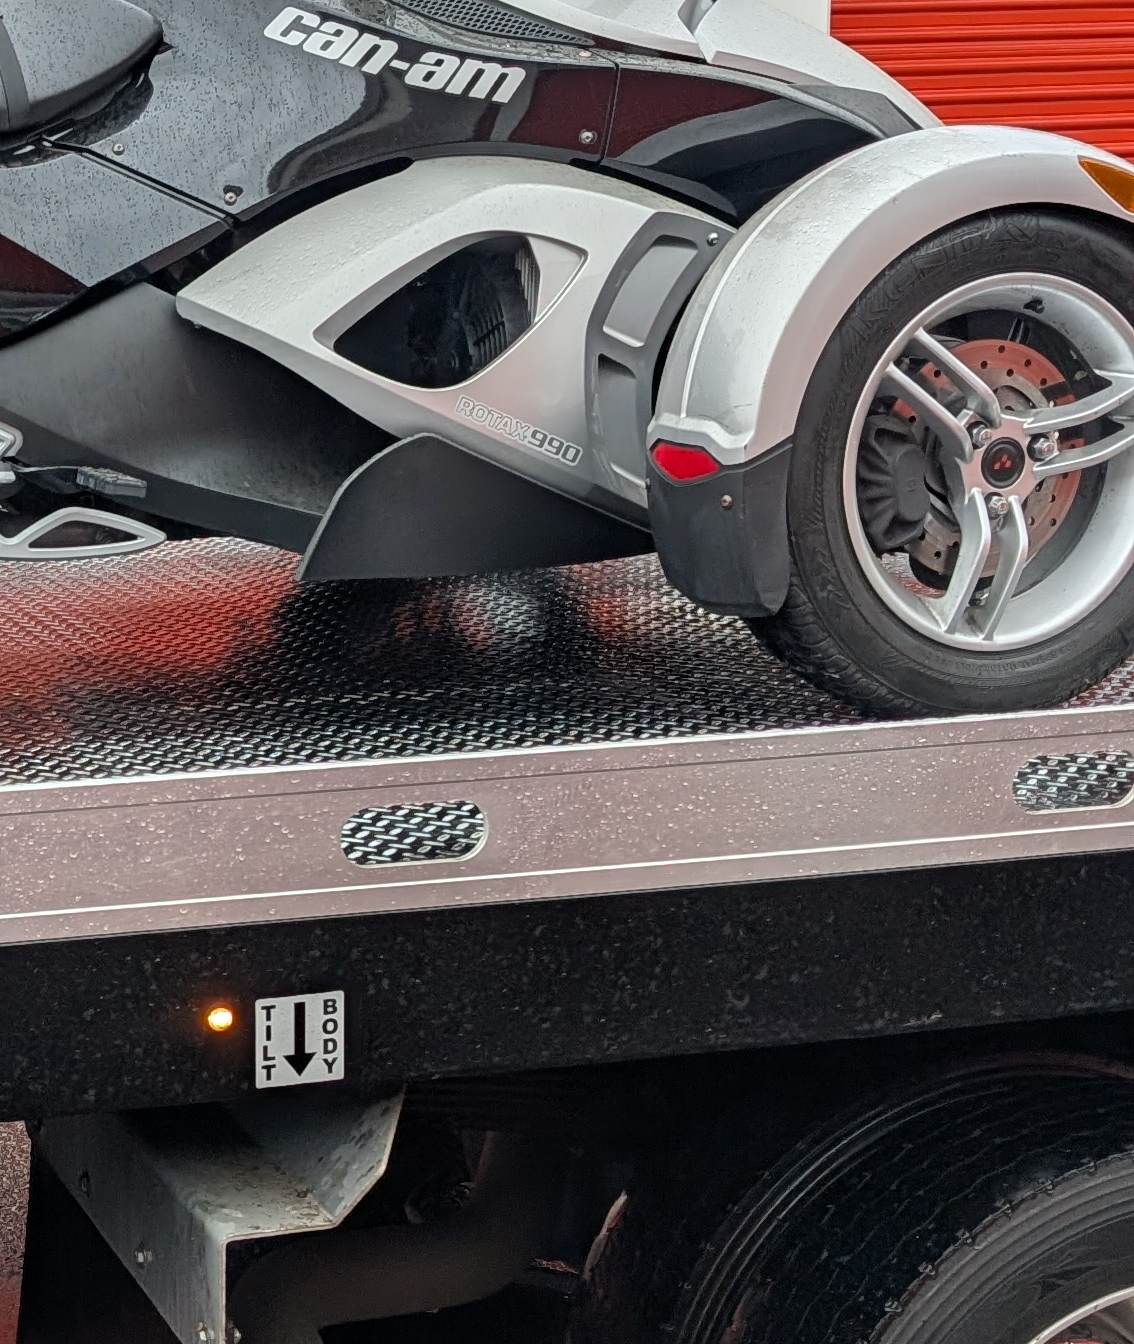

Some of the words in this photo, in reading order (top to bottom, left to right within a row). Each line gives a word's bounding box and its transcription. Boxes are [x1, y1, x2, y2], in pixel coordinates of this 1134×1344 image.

[263, 6, 527, 104] can-am
[454, 395, 531, 443] ROTAX
[527, 428, 582, 465] 990
[261, 1004, 277, 1082] TILT
[322, 998, 339, 1075] BODY
